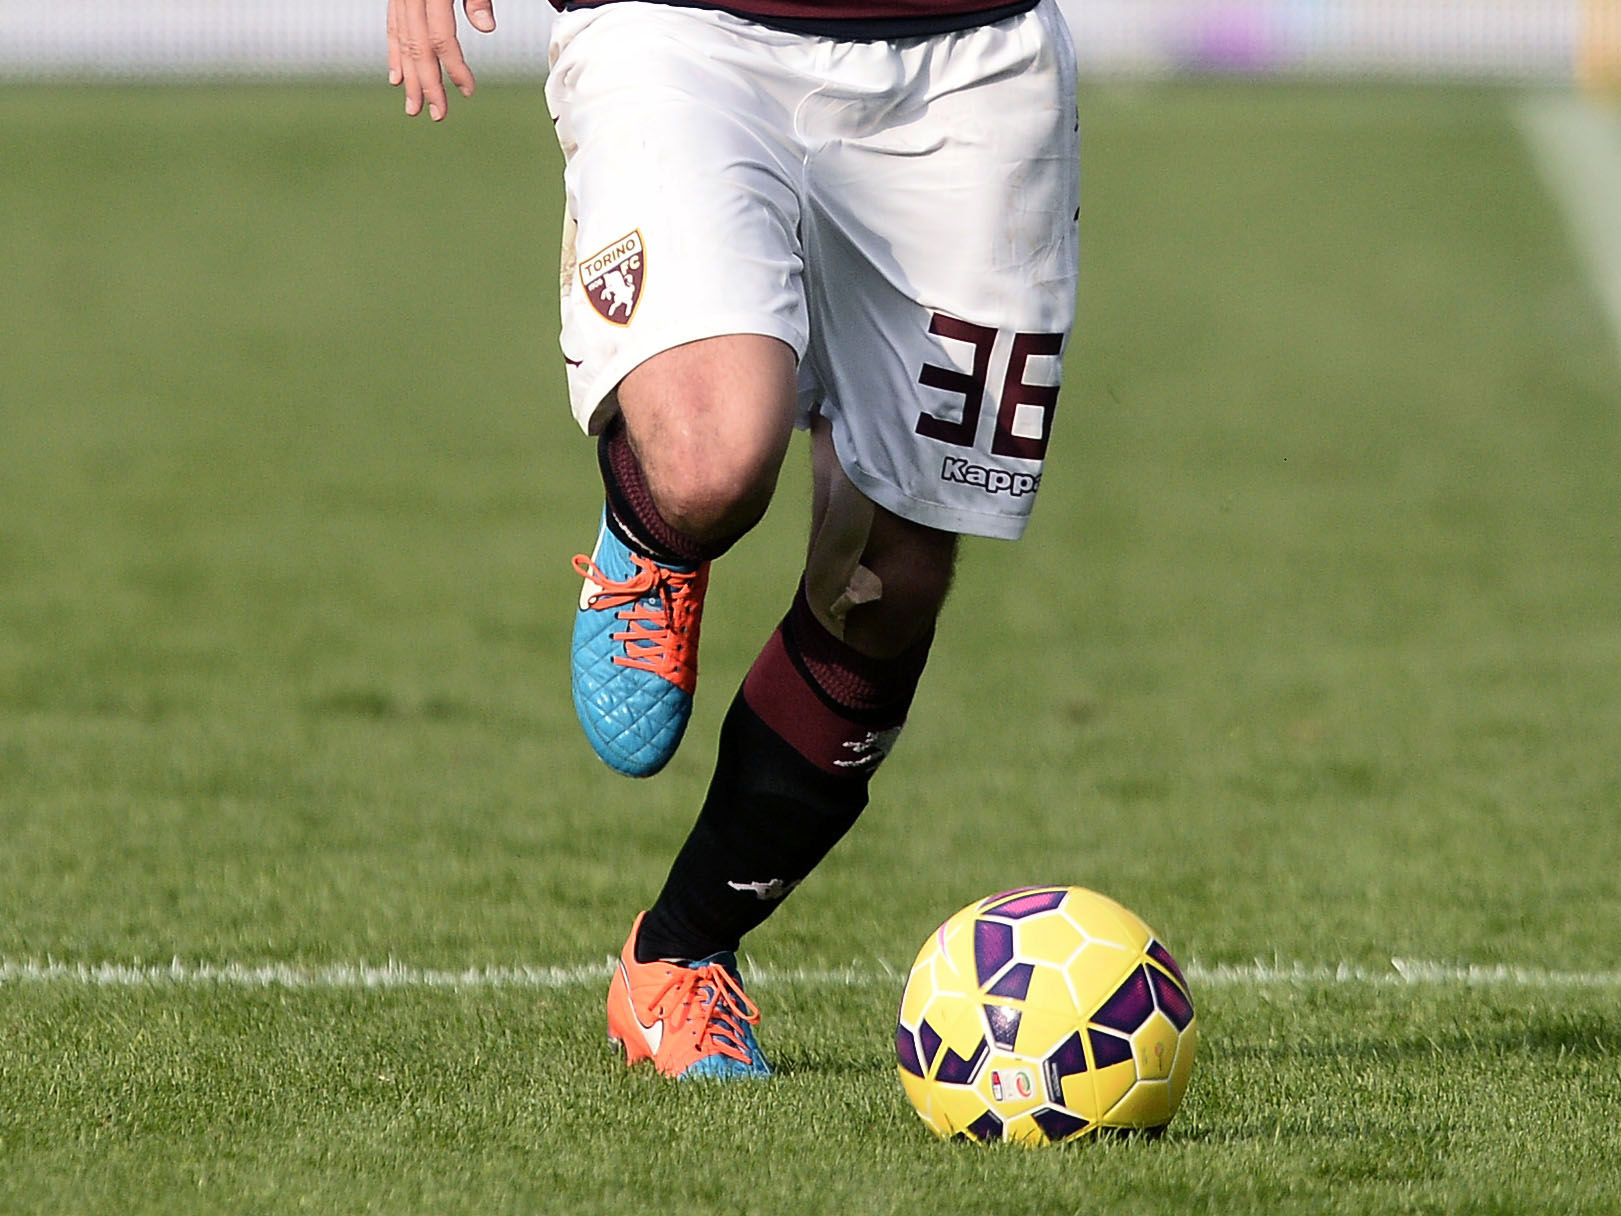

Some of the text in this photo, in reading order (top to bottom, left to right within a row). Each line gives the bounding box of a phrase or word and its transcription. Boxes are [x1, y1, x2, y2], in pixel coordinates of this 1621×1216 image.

[585, 239, 636, 277] TORINO
[619, 255, 641, 276] FC
[915, 311, 1065, 461] 36
